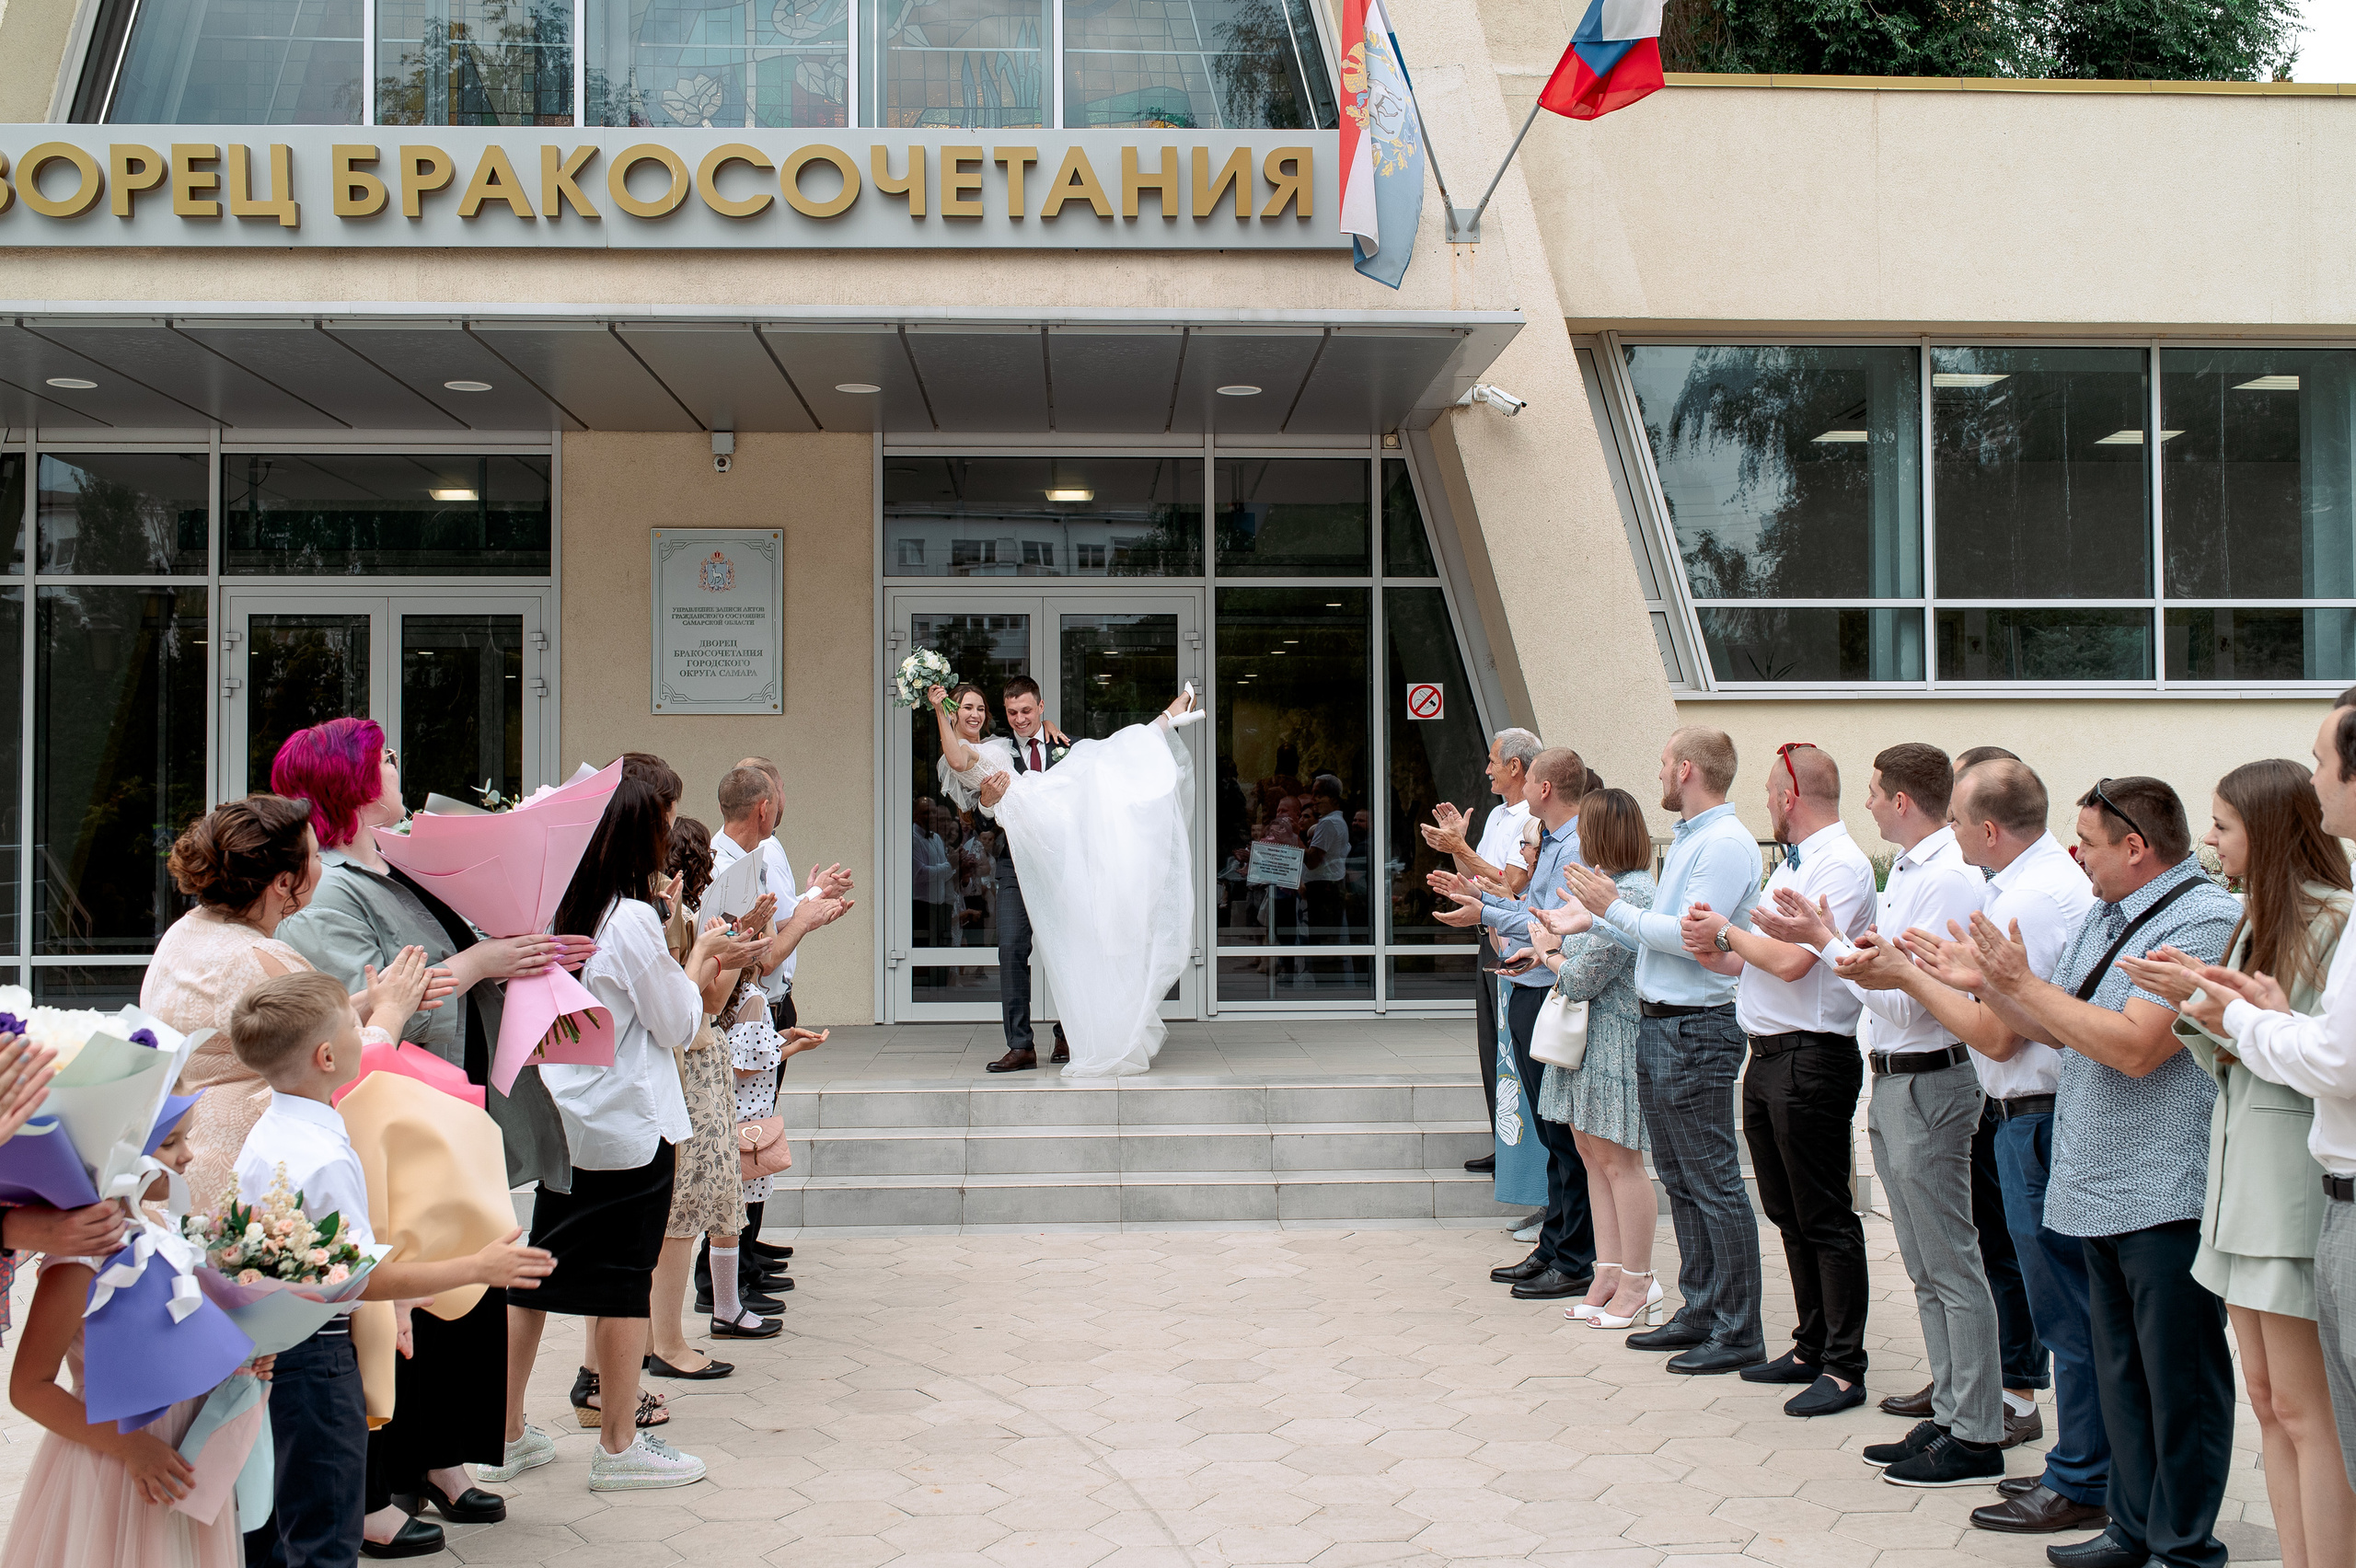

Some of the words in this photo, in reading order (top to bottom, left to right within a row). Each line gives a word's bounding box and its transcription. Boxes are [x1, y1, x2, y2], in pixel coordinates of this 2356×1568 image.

[0, 142, 301, 227] ОРЕЦ
[332, 144, 1314, 219] БРАКОСОЧЕТАНИЯ
[699, 640, 738, 649] ДВОРЕЦ
[687, 660, 750, 668] ГОРОДСКОГО
